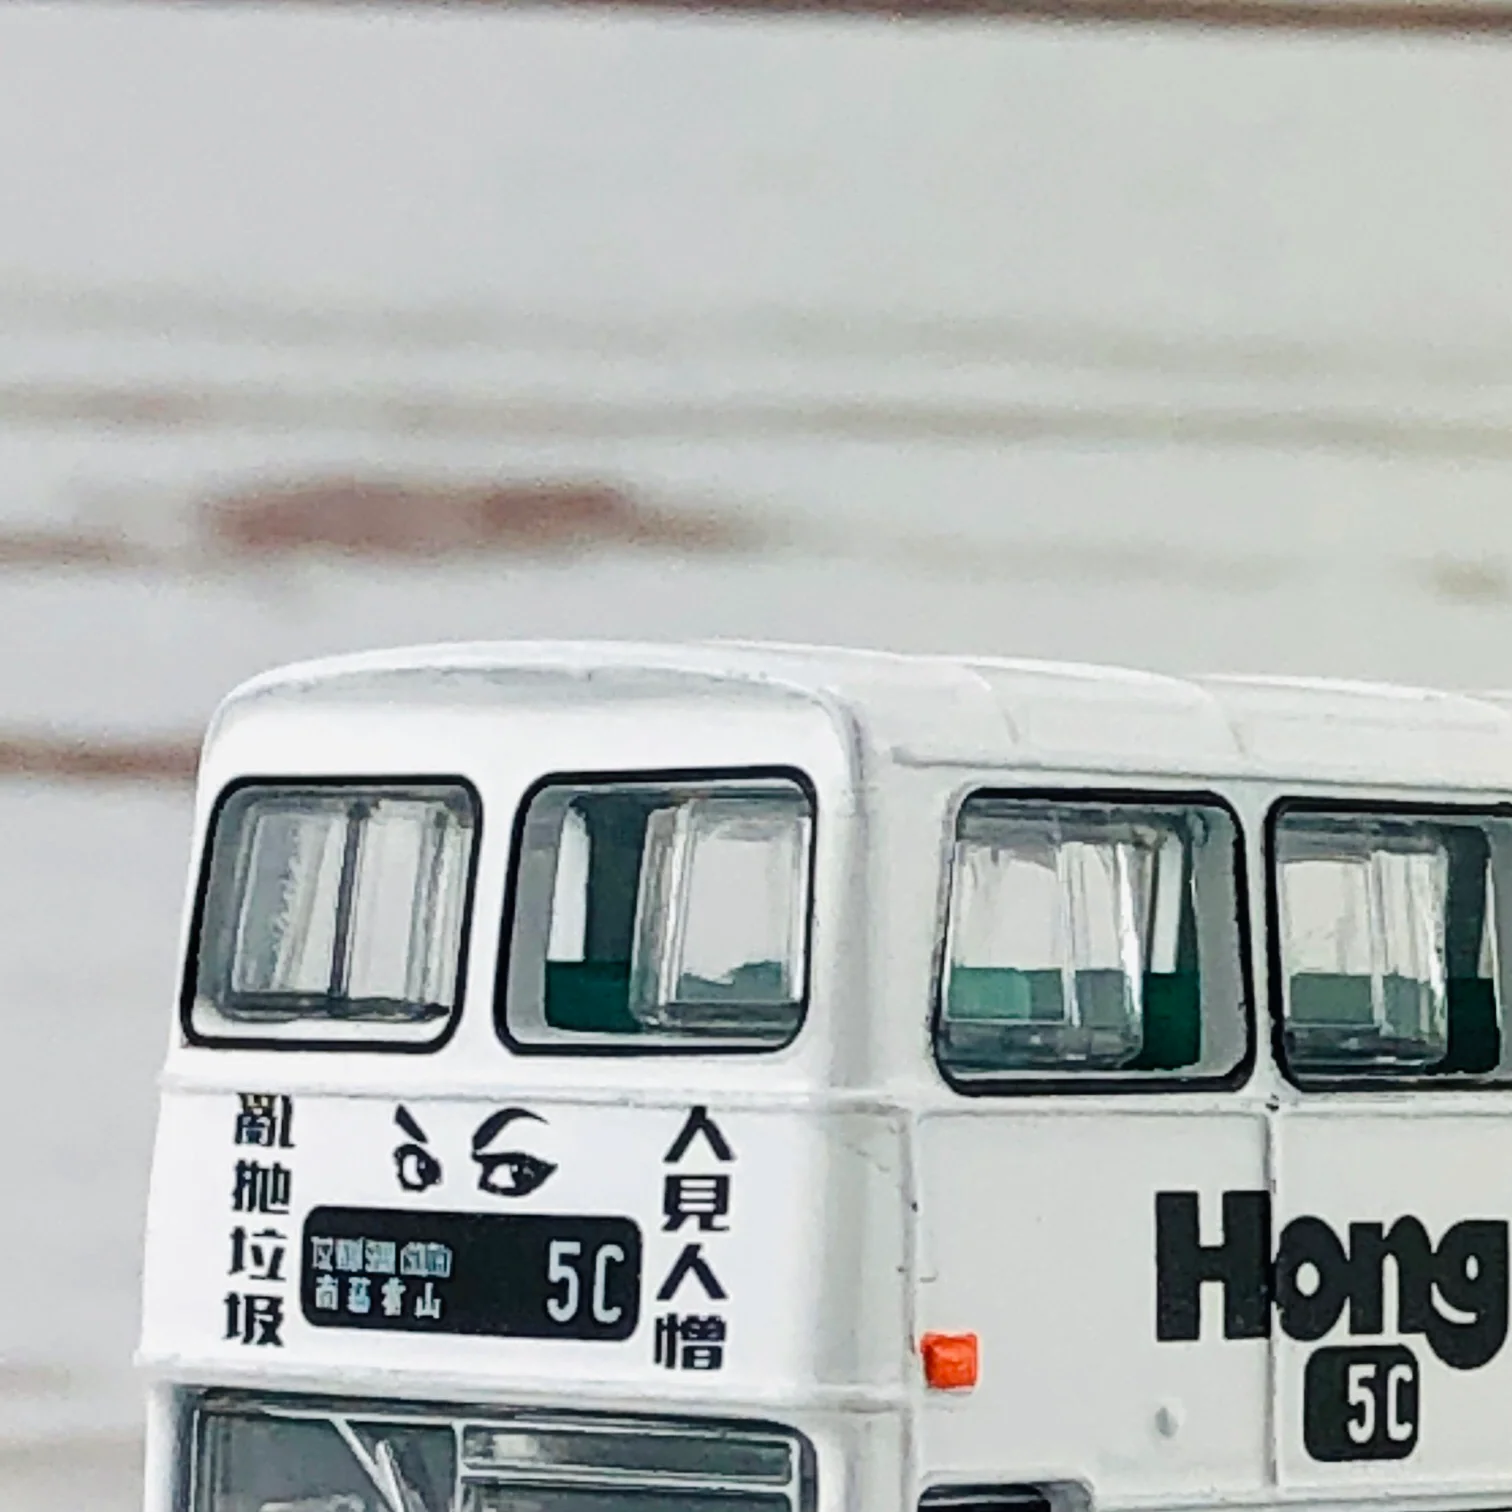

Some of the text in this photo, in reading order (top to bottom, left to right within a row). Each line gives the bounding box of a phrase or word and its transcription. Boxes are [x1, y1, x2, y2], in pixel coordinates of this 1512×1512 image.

[654, 1104, 737, 1370] 人見人憎
[546, 1240, 626, 1325] 5C
[1346, 1362, 1414, 1443] 5C
